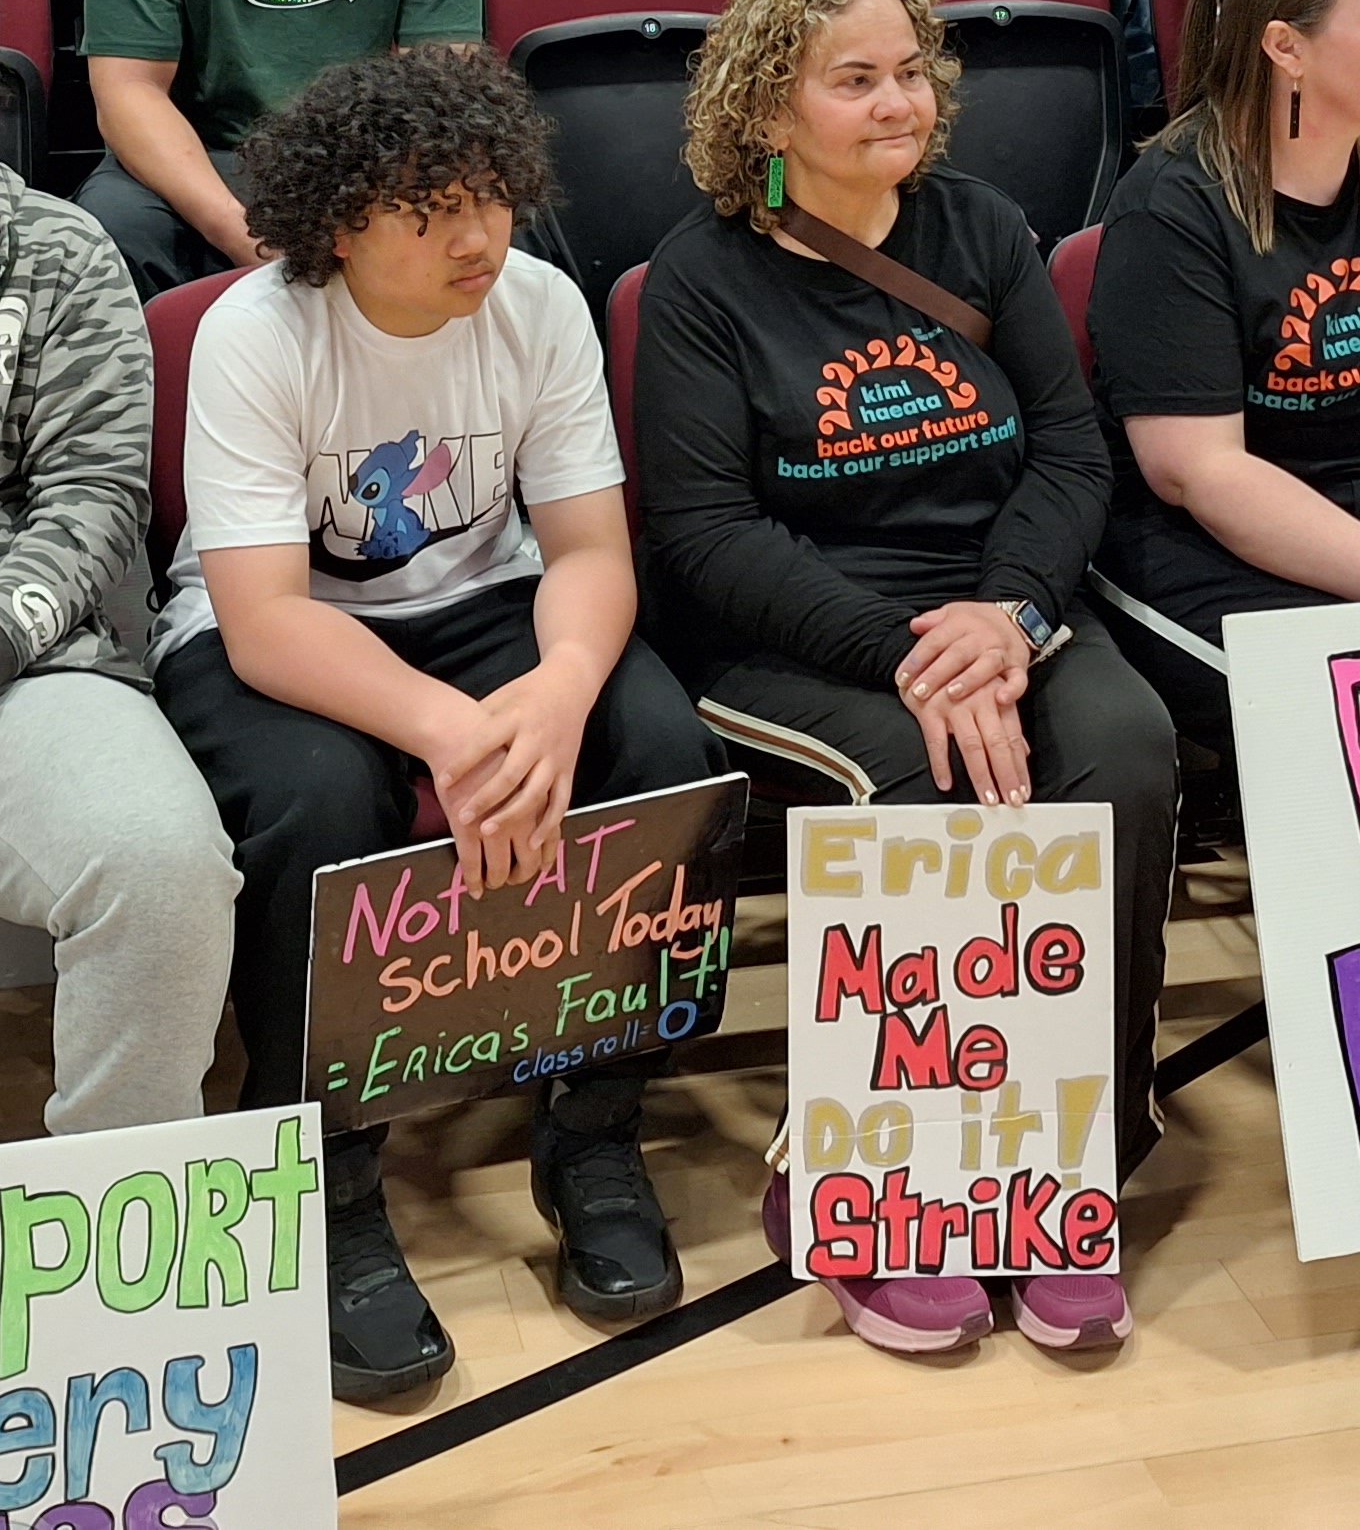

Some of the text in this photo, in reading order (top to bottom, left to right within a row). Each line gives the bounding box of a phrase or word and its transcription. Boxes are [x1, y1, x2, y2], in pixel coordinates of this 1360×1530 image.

[859, 379, 912, 404] kimi
[859, 394, 943, 424] haeata
[1246, 384, 1317, 412] back
[1267, 371, 1335, 392] back
[777, 415, 1018, 479] back our support staff
[817, 410, 990, 459] back our future
[306, 432, 507, 540] NKE
[800, 807, 1102, 900] Erica
[341, 869, 473, 964] Not
[815, 903, 1087, 1024] Made
[869, 1002, 1011, 1093] Me
[960, 1074, 1110, 1190] it!
